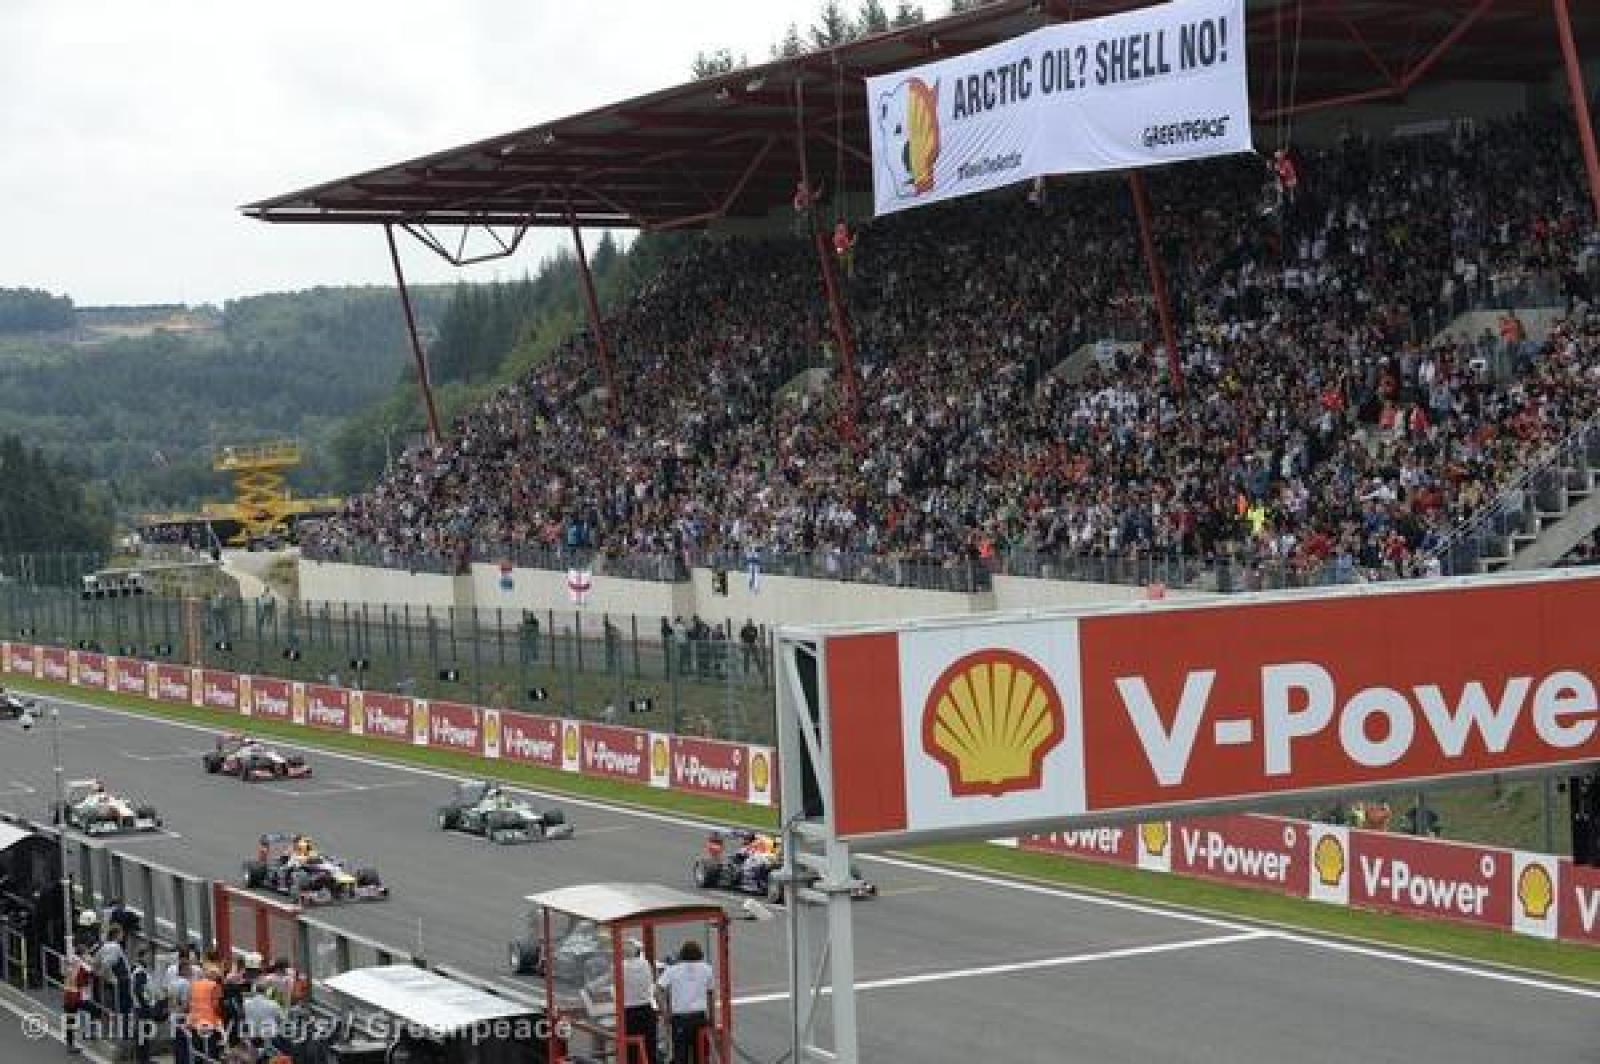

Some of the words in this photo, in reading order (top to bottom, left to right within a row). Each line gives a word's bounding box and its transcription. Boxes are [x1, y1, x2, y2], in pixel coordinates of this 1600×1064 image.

[953, 57, 1033, 120] ARCTIC
[1040, 45, 1088, 94] OIL?
[1095, 29, 1169, 86] SHELL
[1180, 16, 1228, 69] NO!
[1143, 115, 1230, 147] GREENPEACE
[584, 737, 640, 774] V-Power
[674, 752, 738, 790] V-Power
[1181, 827, 1291, 882] V-Power
[1360, 854, 1489, 915] V-Power
